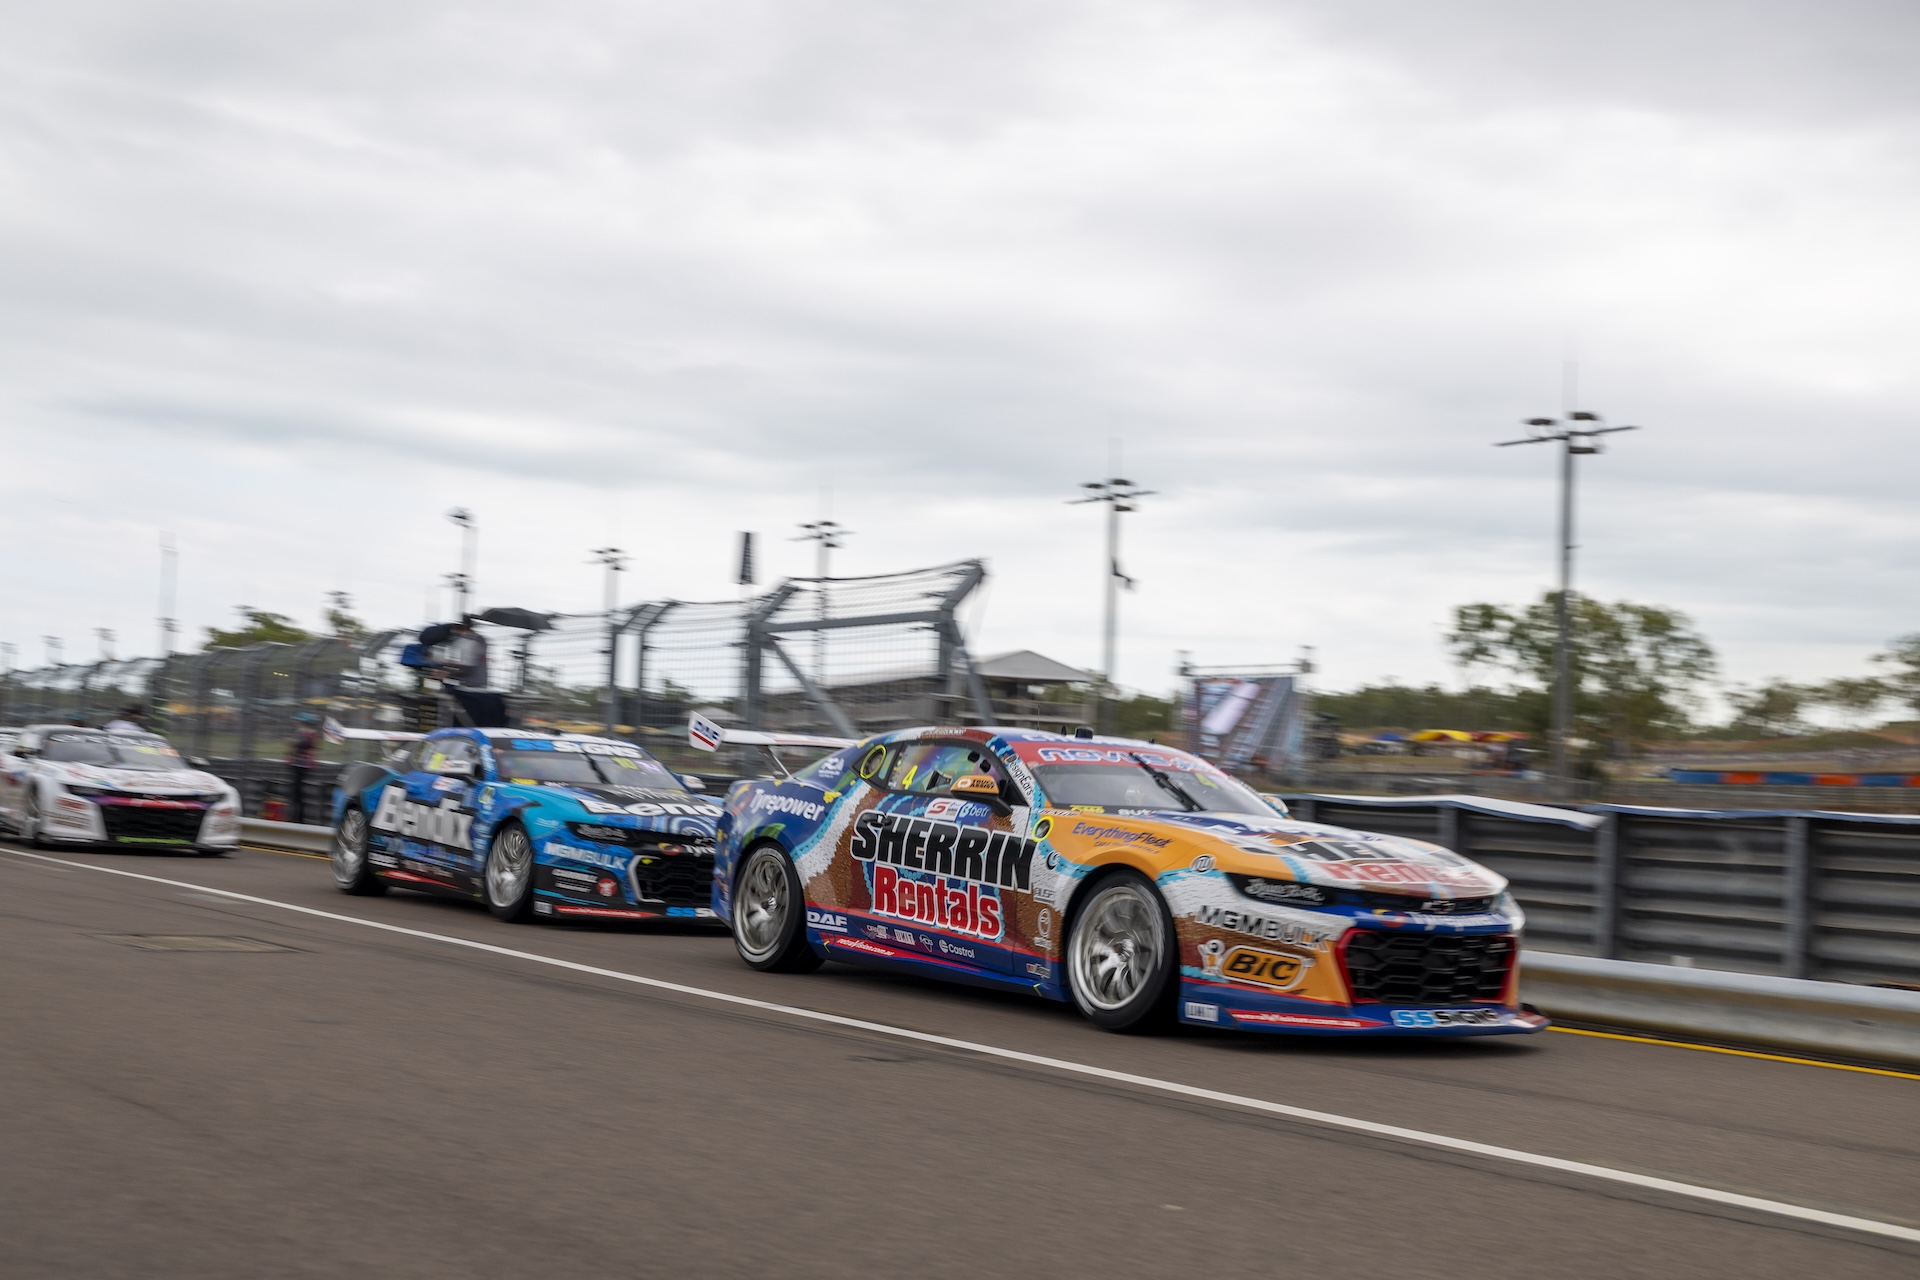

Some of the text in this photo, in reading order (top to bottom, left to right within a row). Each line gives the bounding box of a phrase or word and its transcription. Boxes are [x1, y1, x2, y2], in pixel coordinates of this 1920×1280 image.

[902, 764, 919, 790] 4
[750, 788, 825, 821] Tyrepower
[851, 812, 1038, 893] SHERRIN
[873, 865, 1000, 938] Rentals
[807, 911, 848, 927] DAF
[1196, 904, 1330, 952] MGMBULK
[949, 945, 975, 958] Castrol
